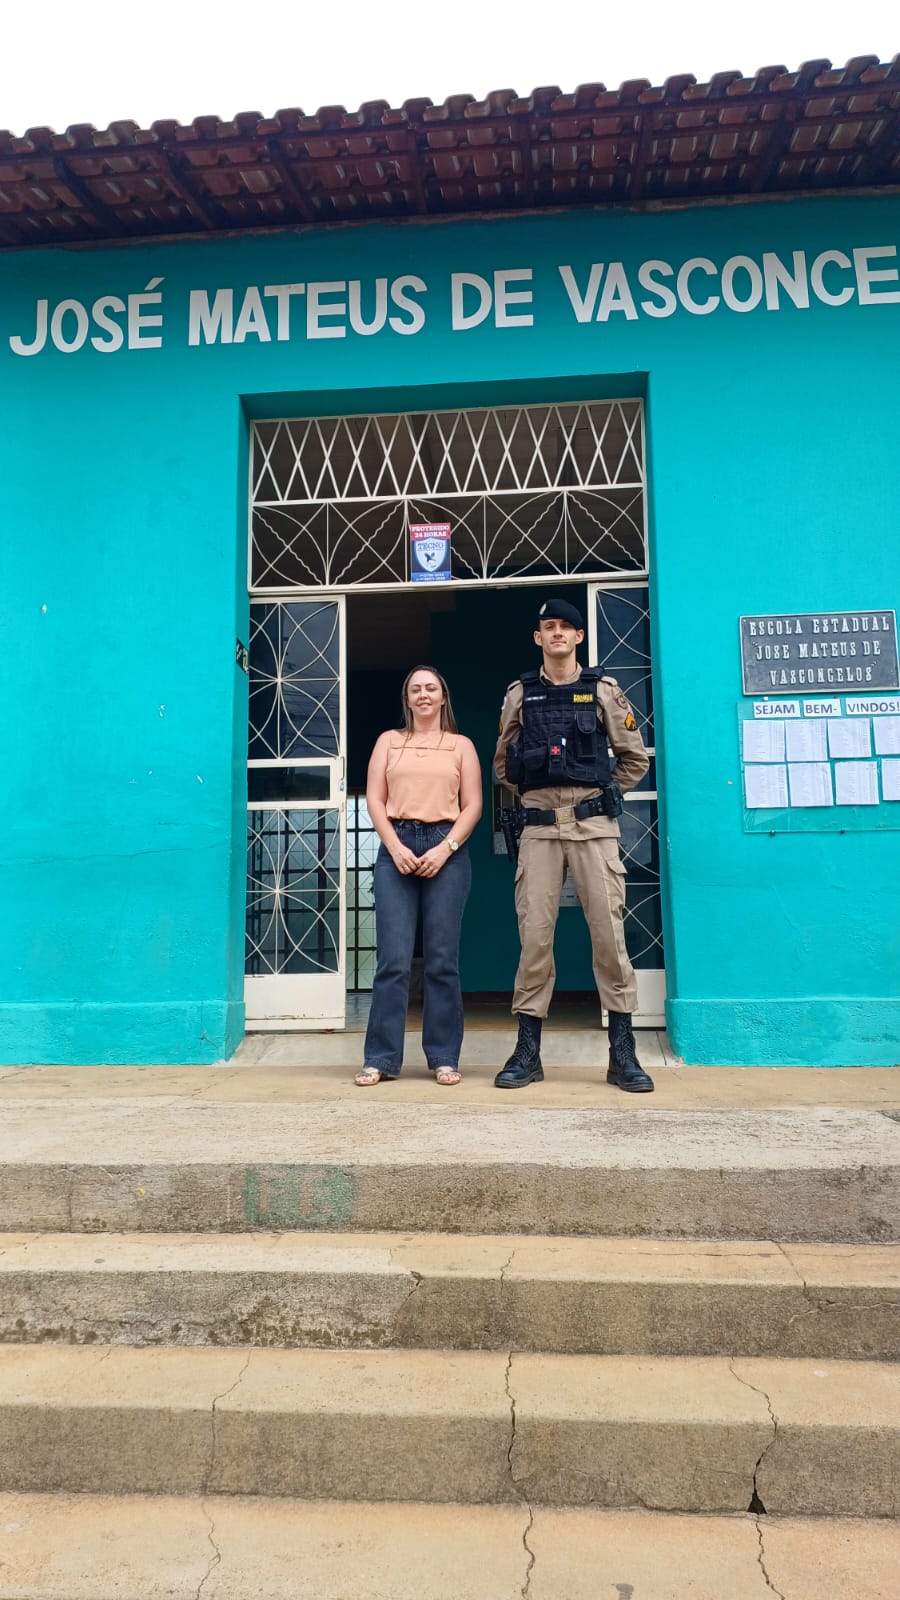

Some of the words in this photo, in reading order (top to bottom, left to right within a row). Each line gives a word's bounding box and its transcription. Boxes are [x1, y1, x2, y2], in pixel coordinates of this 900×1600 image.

[9, 277, 165, 356] JOSÉ
[188, 275, 428, 346] MATEUS
[451, 268, 534, 330] DE
[558, 245, 900, 323] VASCONCE
[417, 542, 444, 550] TECNO
[750, 620, 803, 636] ESCOLA
[812, 616, 890, 633] ESTADUAL
[799, 642, 857, 658] MATEUS
[863, 640, 881, 655] DE
[755, 704, 795, 715] SEJAM
[805, 703, 838, 714] BEM-
[848, 702, 900, 713] VINDOS!
